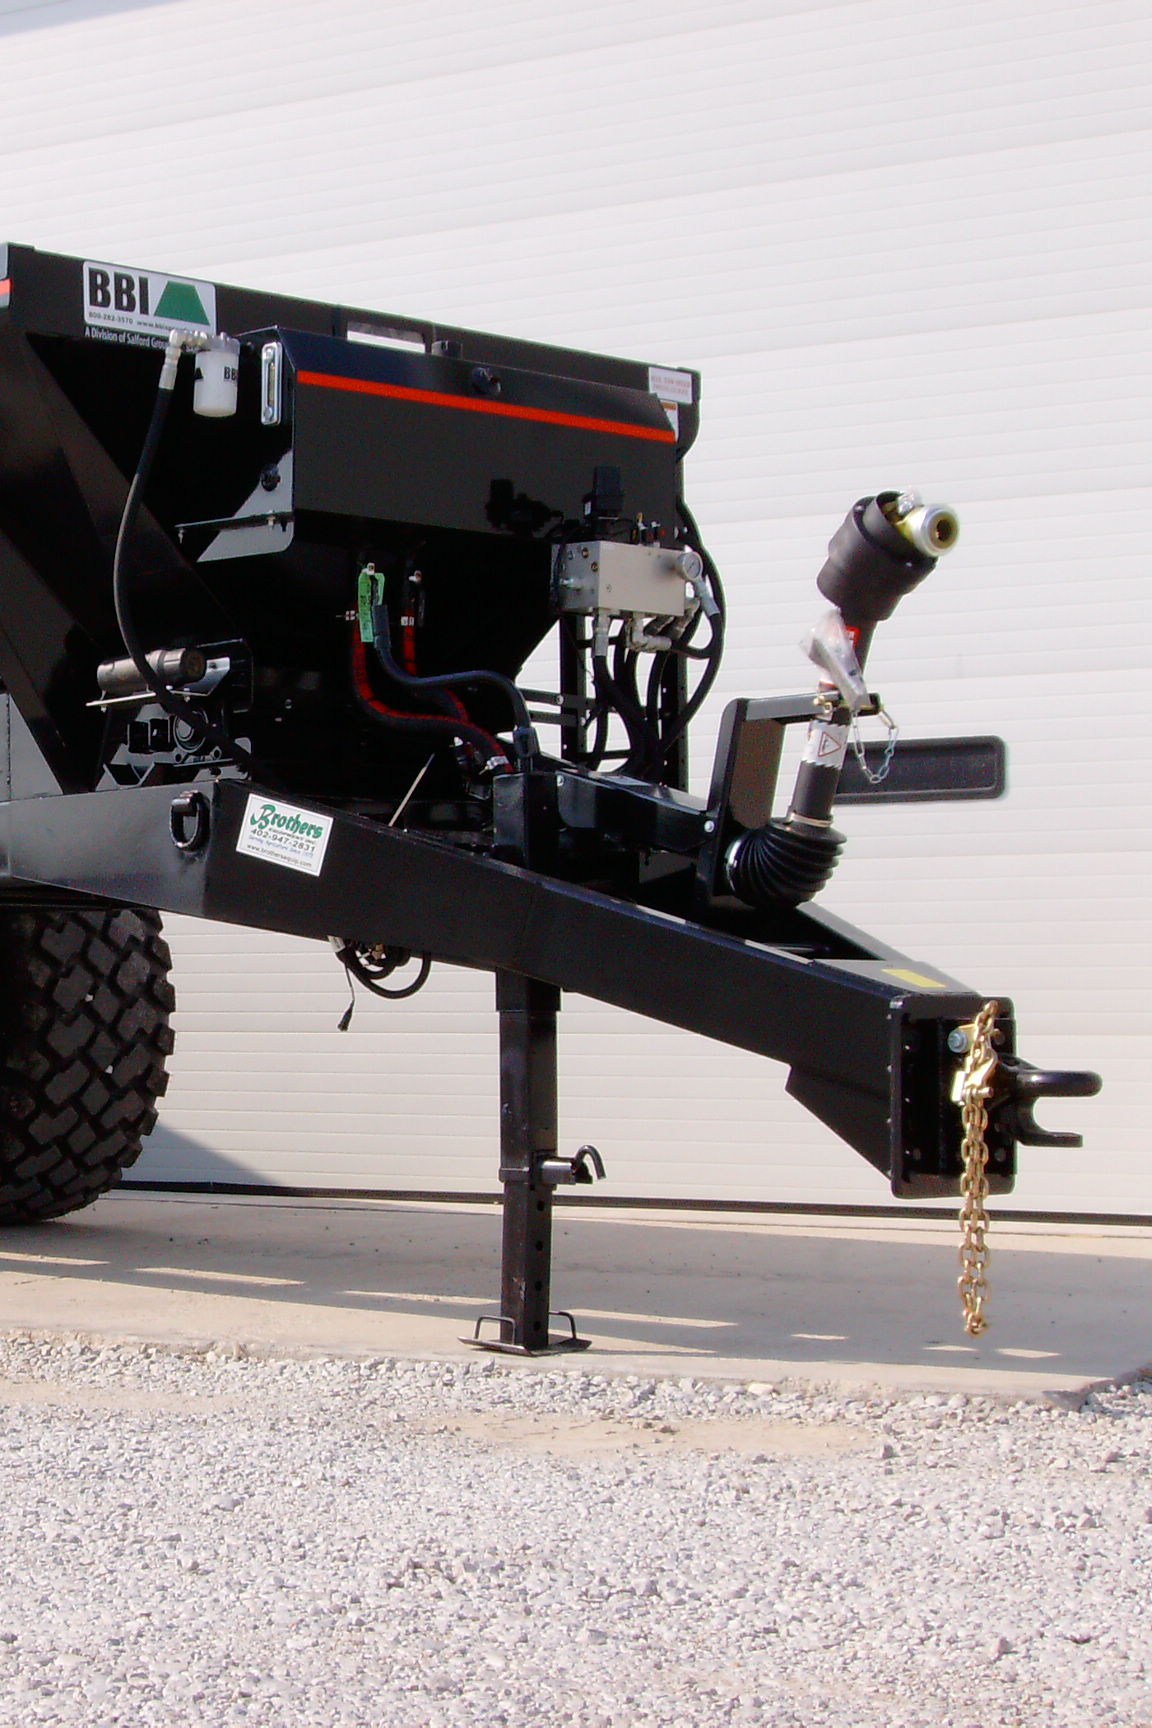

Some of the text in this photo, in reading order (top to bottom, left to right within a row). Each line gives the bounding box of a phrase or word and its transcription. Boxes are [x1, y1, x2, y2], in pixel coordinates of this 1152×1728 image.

[88, 267, 150, 316] BBI
[84, 326, 90, 337] A
[91, 327, 118, 342] Division
[118, 332, 126, 343] of
[127, 333, 150, 347] Salford
[250, 804, 324, 839] Brothers
[251, 828, 316, 852] 402-947-2831
